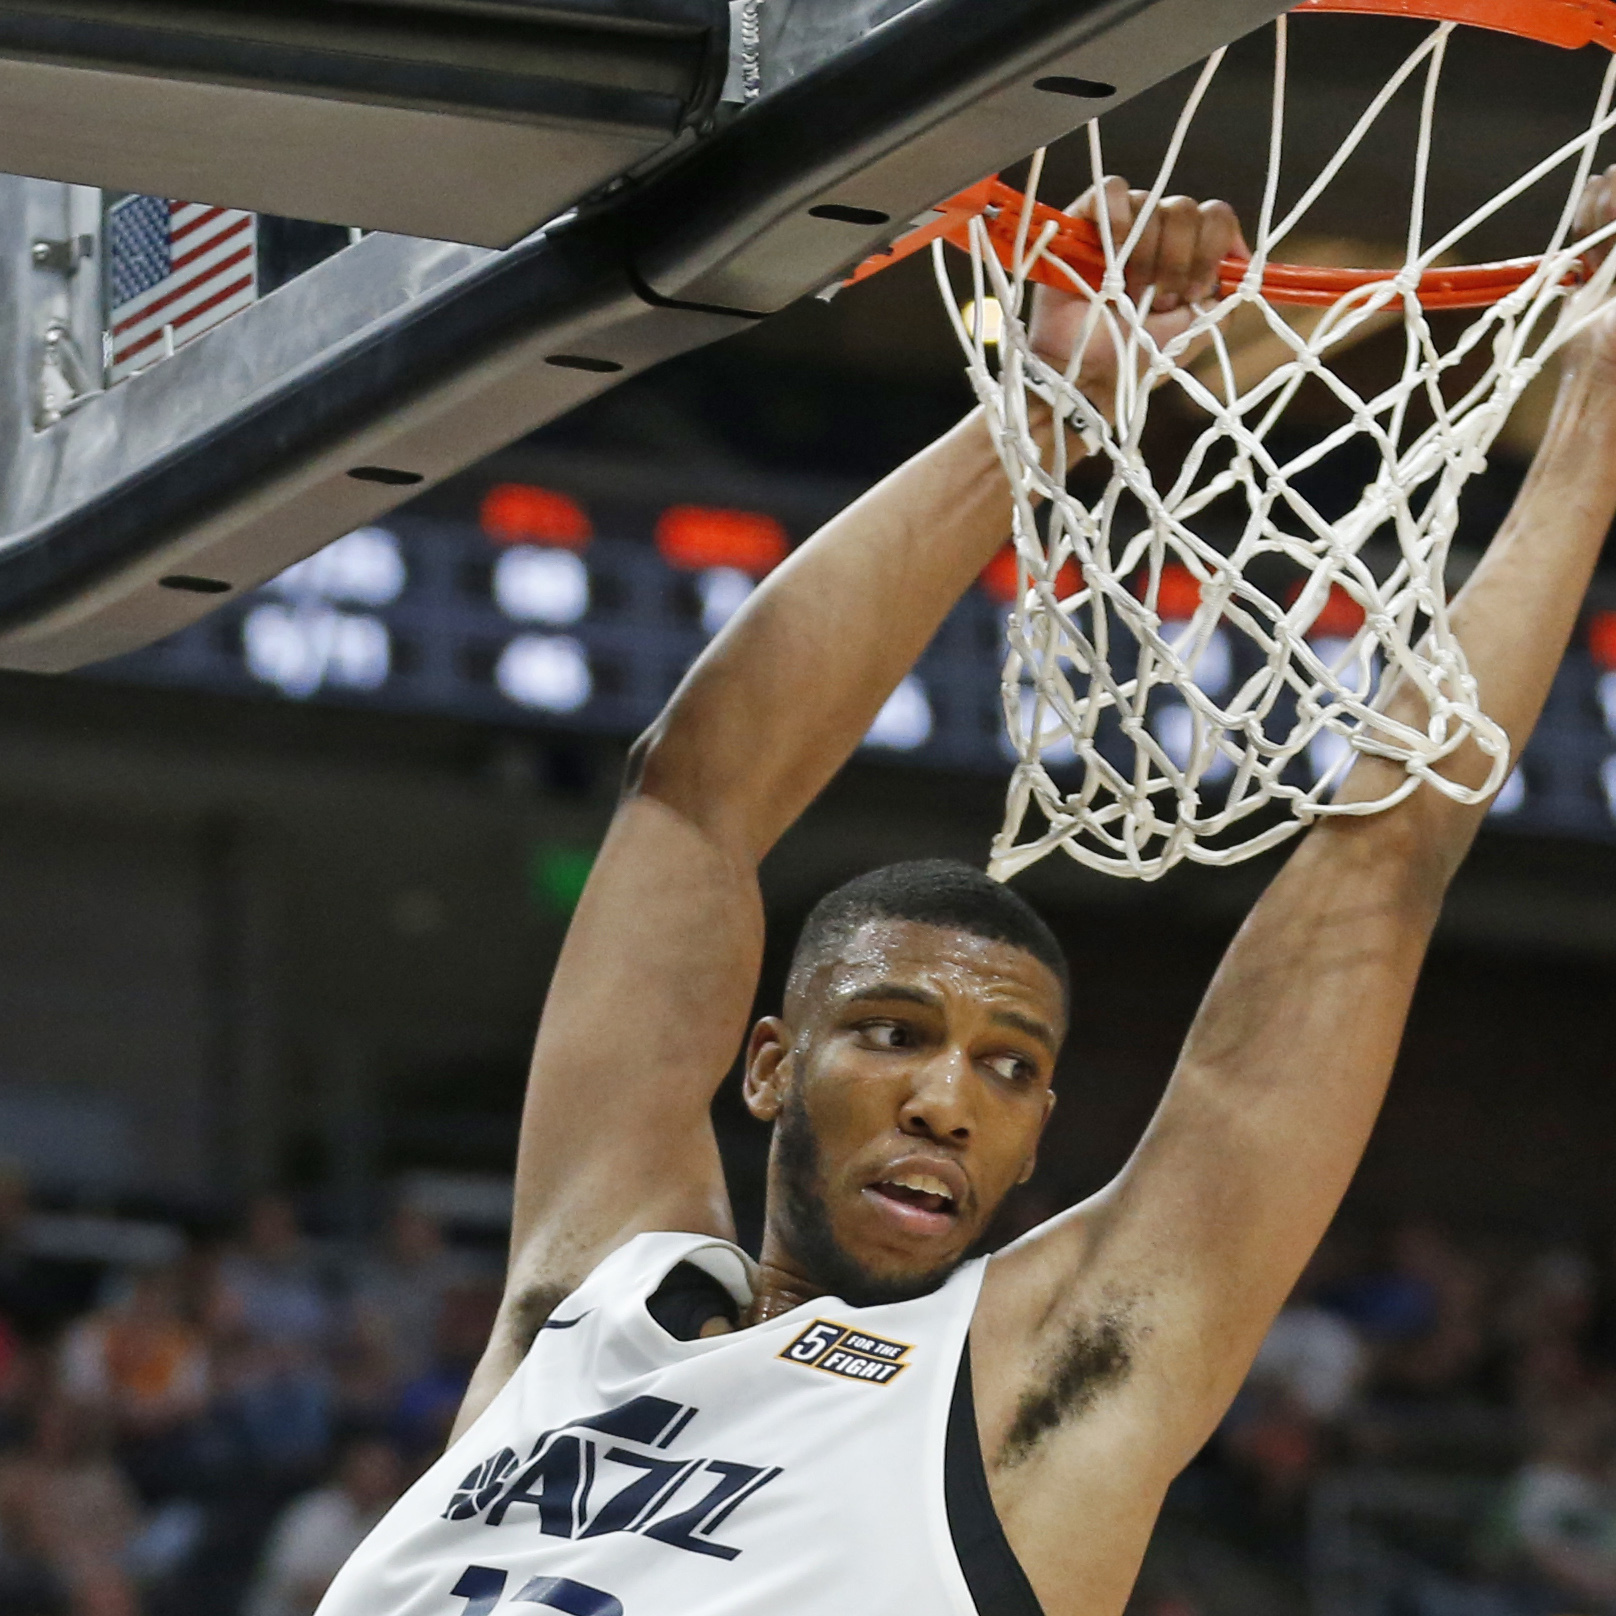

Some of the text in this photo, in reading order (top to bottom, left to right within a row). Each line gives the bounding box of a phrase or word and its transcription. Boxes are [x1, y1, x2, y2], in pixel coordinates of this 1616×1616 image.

[790, 1324, 839, 1361] 5
[846, 1335, 902, 1358] FOR THE
[823, 1352, 898, 1381] FIGHT
